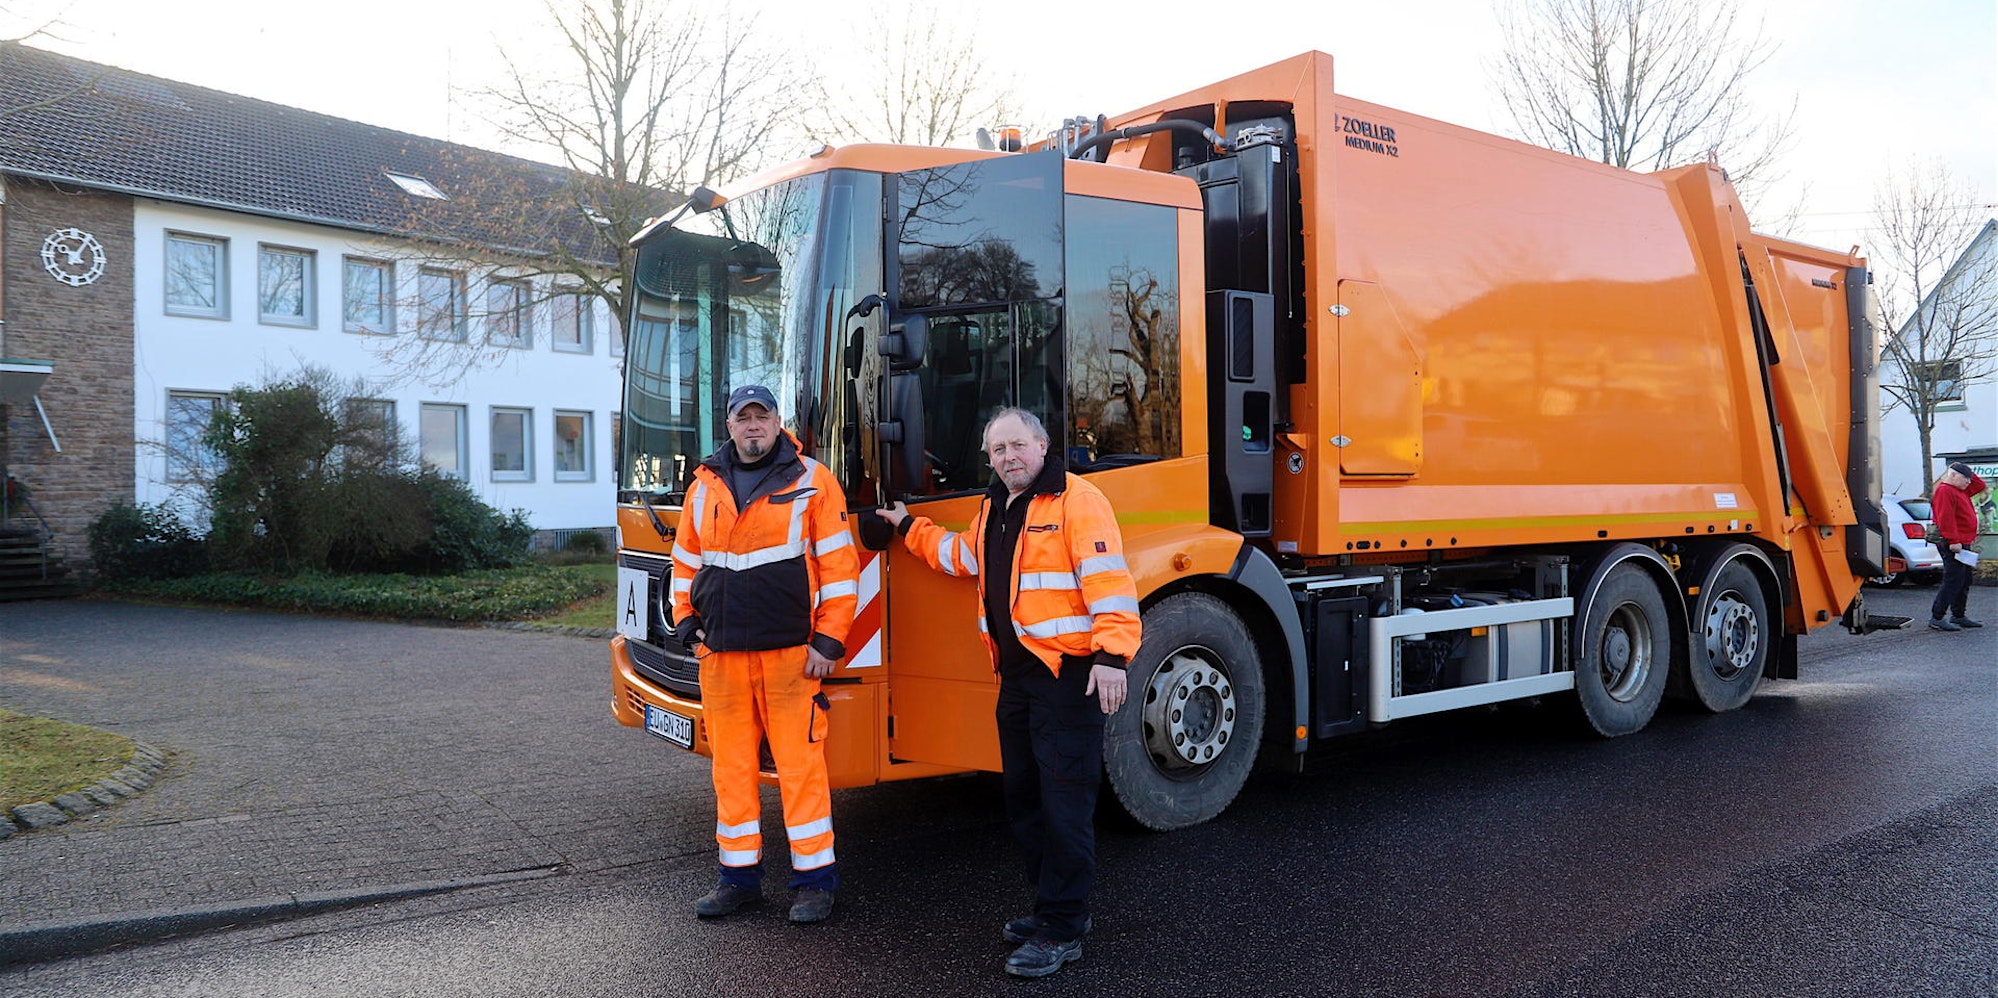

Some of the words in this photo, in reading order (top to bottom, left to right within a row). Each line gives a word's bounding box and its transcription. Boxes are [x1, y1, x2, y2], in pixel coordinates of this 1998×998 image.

[1342, 116, 1396, 143] ZOELLER
[1345, 135, 1385, 155] MEDIUM
[1386, 144, 1399, 158] X2
[625, 580, 637, 627] A
[675, 718, 691, 742] 310
